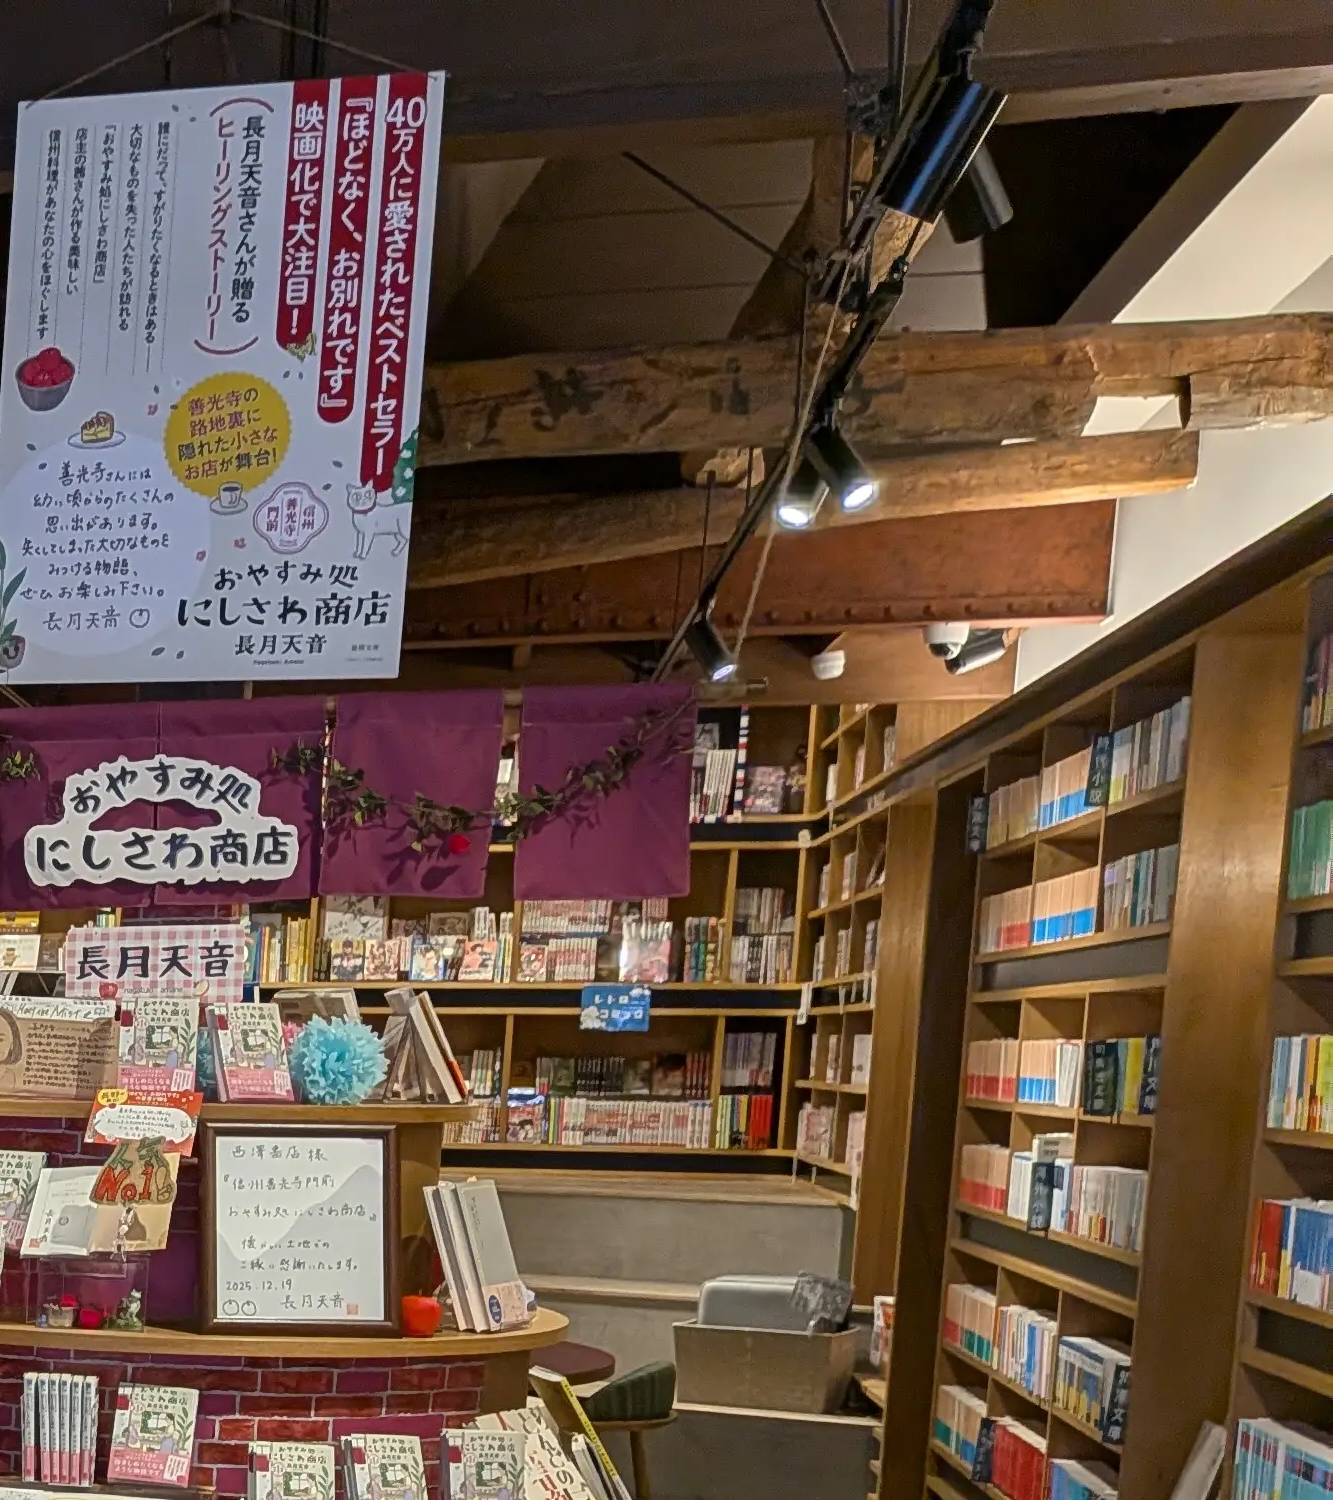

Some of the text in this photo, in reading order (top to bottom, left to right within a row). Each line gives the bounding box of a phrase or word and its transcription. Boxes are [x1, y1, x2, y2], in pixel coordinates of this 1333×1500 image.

[204, 117, 236, 341] ヒーリングストーリー
[229, 115, 266, 324] 長月天音さんが贈る
[319, 97, 373, 407] 『ほどなく、お別れです』
[367, 96, 426, 475] 40万人に愛されたベストセラー
[187, 387, 259, 418] 善光寺の
[189, 408, 262, 438] 路地裏に
[177, 426, 279, 462] 隠れた小さな
[57, 460, 153, 487] 善光寺さんには
[213, 560, 359, 591] おやすみ処
[42, 605, 121, 633] 長月天音
[177, 590, 392, 628] にしさわ商店
[234, 633, 329, 656] 長月天音
[70, 758, 252, 815] おやすみ処
[36, 826, 294, 872] にしさわ商店
[76, 940, 235, 981] 長月天音
[225, 1278, 292, 1291] 2025.12.19
[280, 1291, 345, 1310] 長月天音
